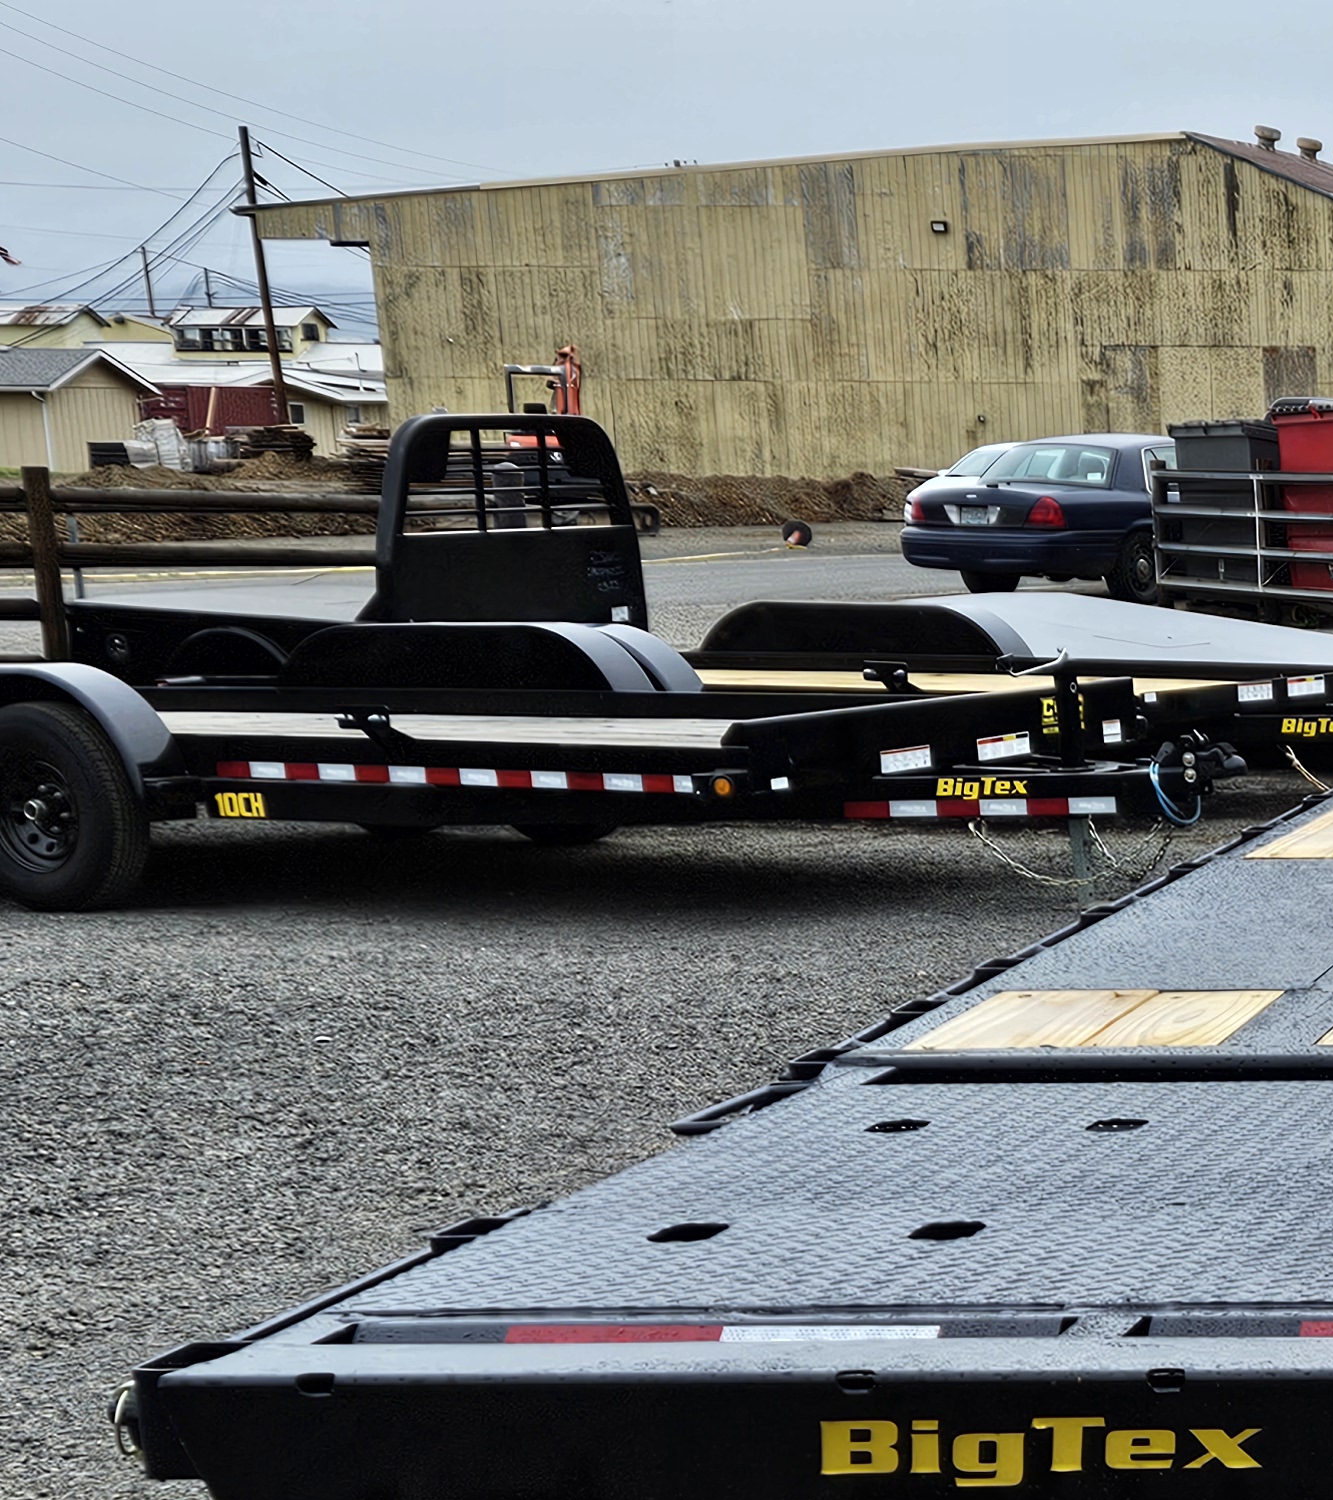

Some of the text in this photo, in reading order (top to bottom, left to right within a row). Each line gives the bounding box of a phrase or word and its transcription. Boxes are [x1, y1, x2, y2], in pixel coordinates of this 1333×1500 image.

[936, 776, 1028, 800] BigTex
[214, 792, 266, 817] 10CH
[820, 1417, 1263, 1487] BigTex
